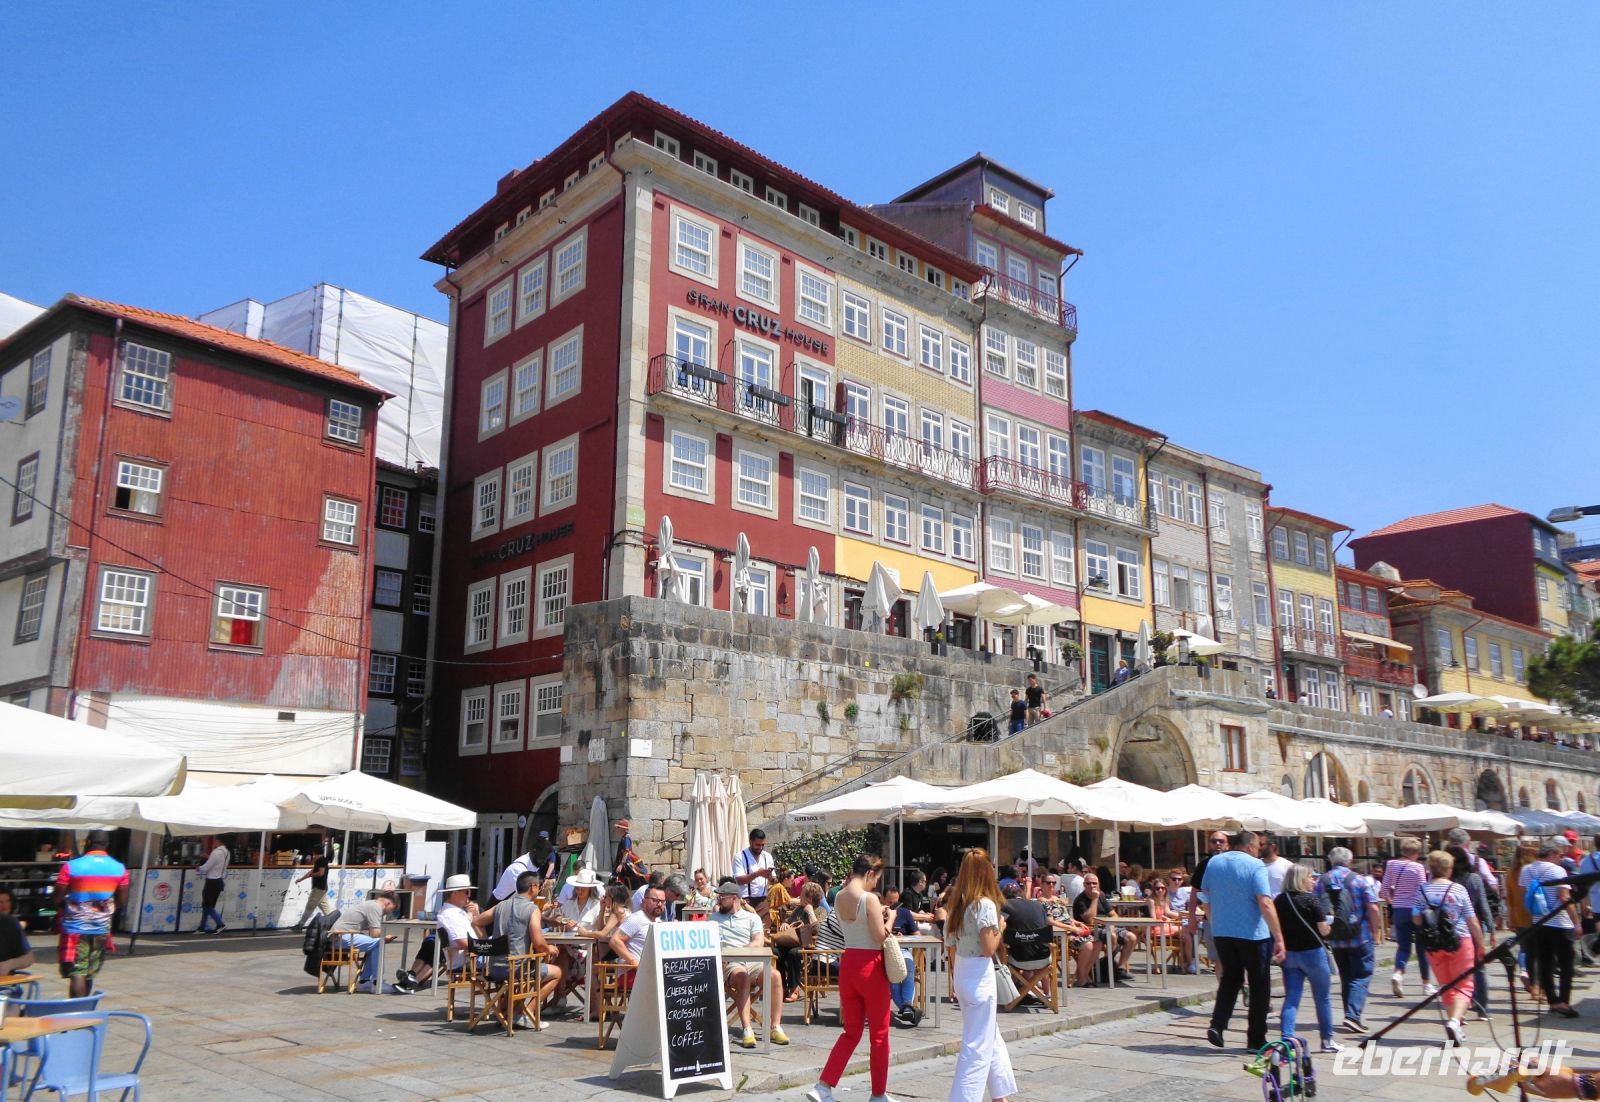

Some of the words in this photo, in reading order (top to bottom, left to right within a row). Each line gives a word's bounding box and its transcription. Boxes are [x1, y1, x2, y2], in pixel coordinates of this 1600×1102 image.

[733, 305, 783, 338] CRUZ
[784, 327, 830, 353] HOUSE
[498, 533, 533, 559] CRUZ
[660, 929, 686, 952] GIN
[688, 928, 716, 950] SUL
[664, 958, 711, 975] BREAKFAST
[676, 996, 699, 1006] TOAST
[667, 1006, 707, 1020] CROISSANT
[685, 1020, 692, 1031] &
[671, 1031, 705, 1047] COFFEE
